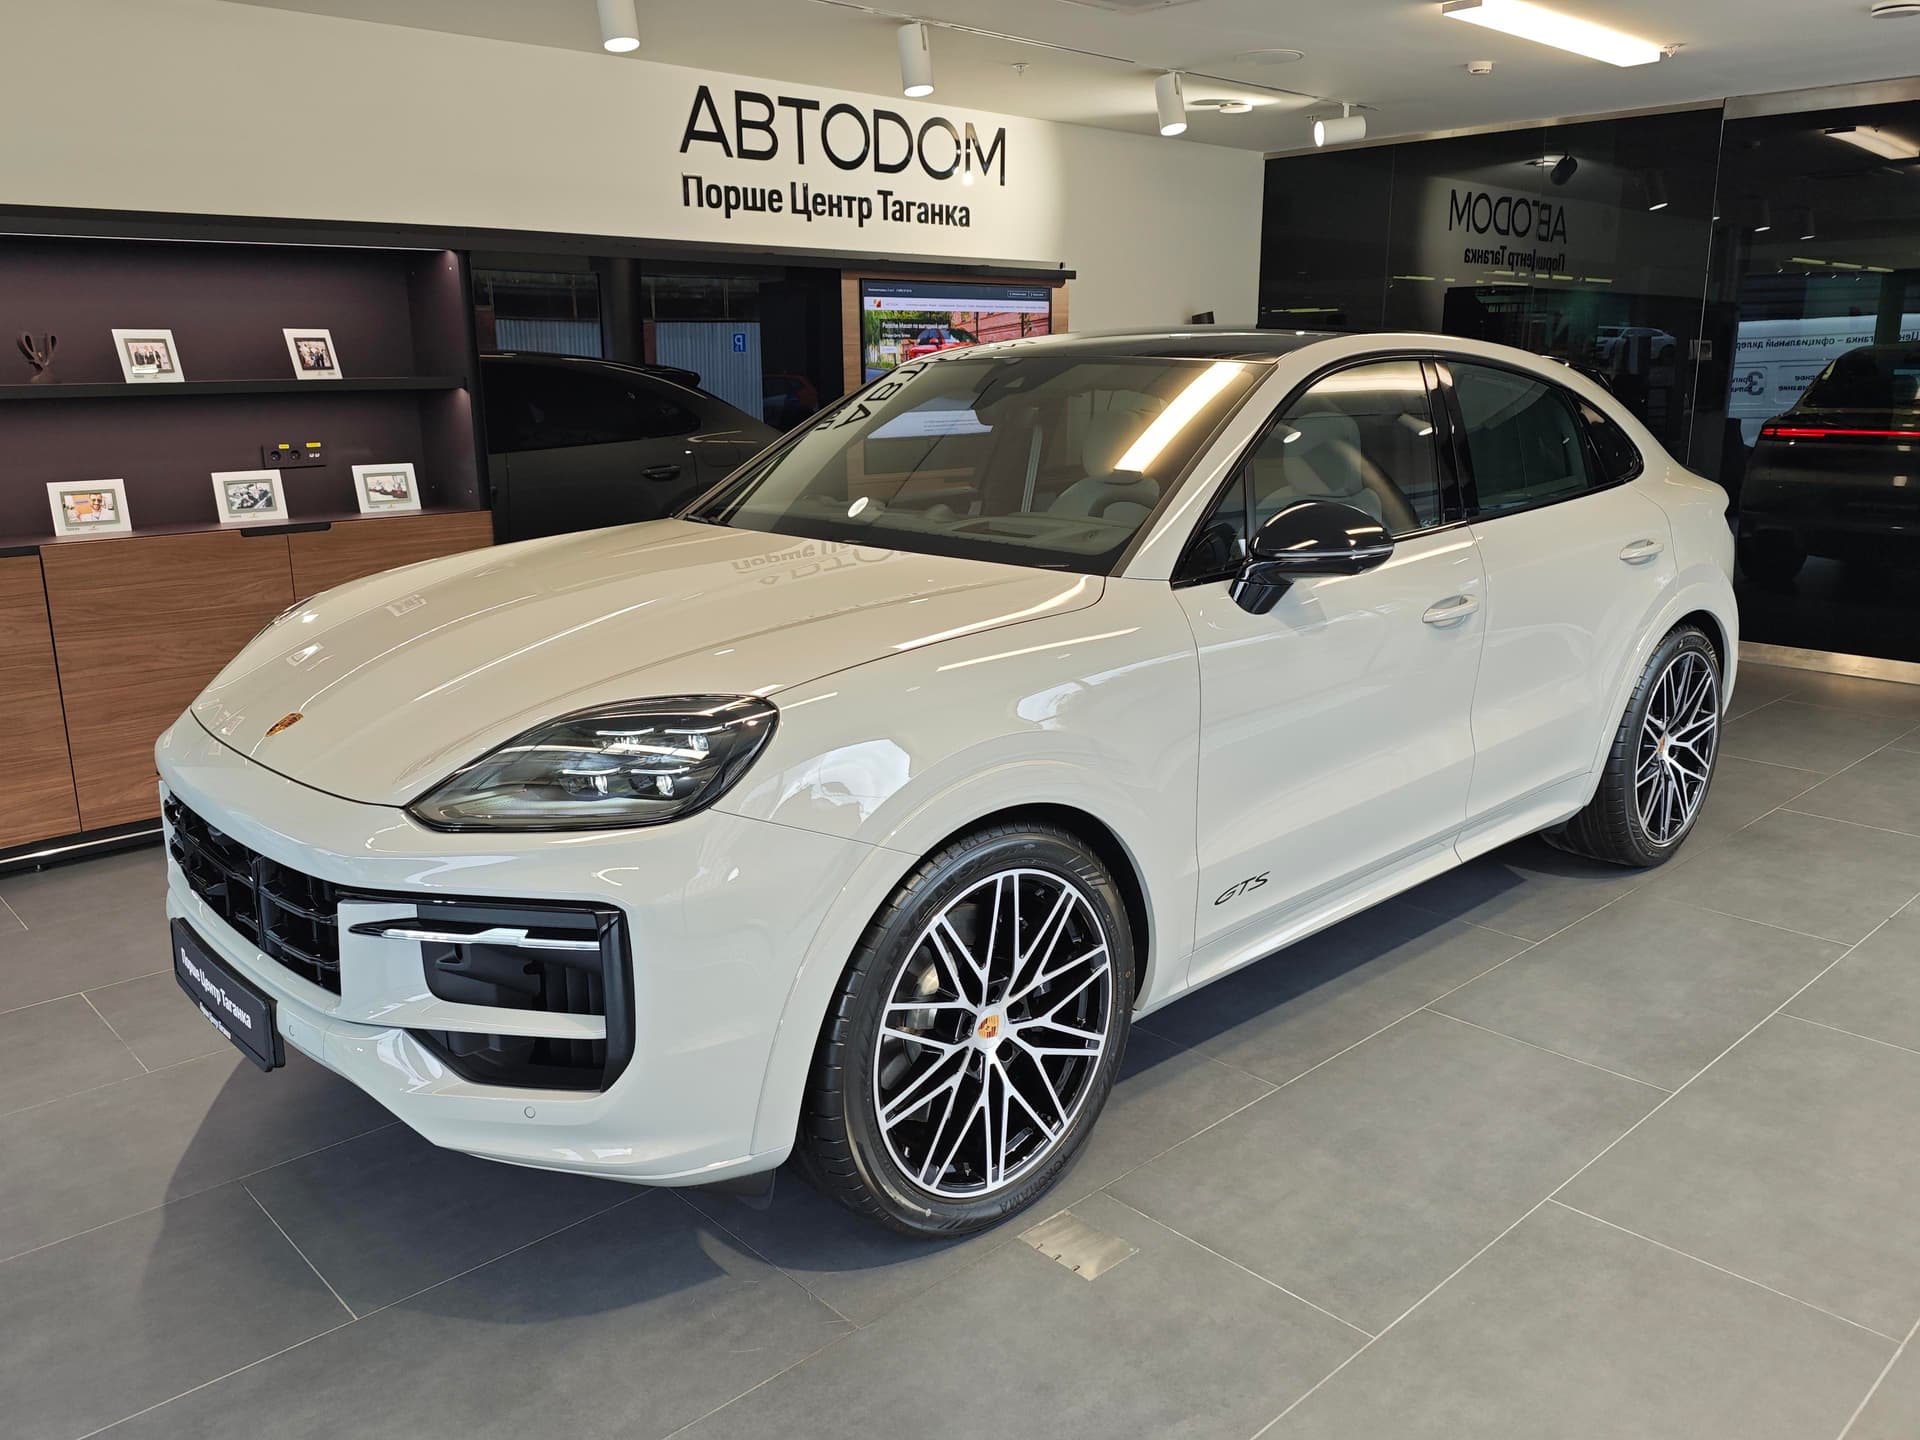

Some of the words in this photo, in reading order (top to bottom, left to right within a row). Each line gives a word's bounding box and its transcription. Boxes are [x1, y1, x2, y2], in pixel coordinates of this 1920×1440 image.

[681, 172, 784, 219] Порше
[790, 181, 873, 228] Центр
[877, 189, 971, 228] Таганка
[1214, 871, 1271, 905] GTS
[220, 988, 252, 1029] Таганка
